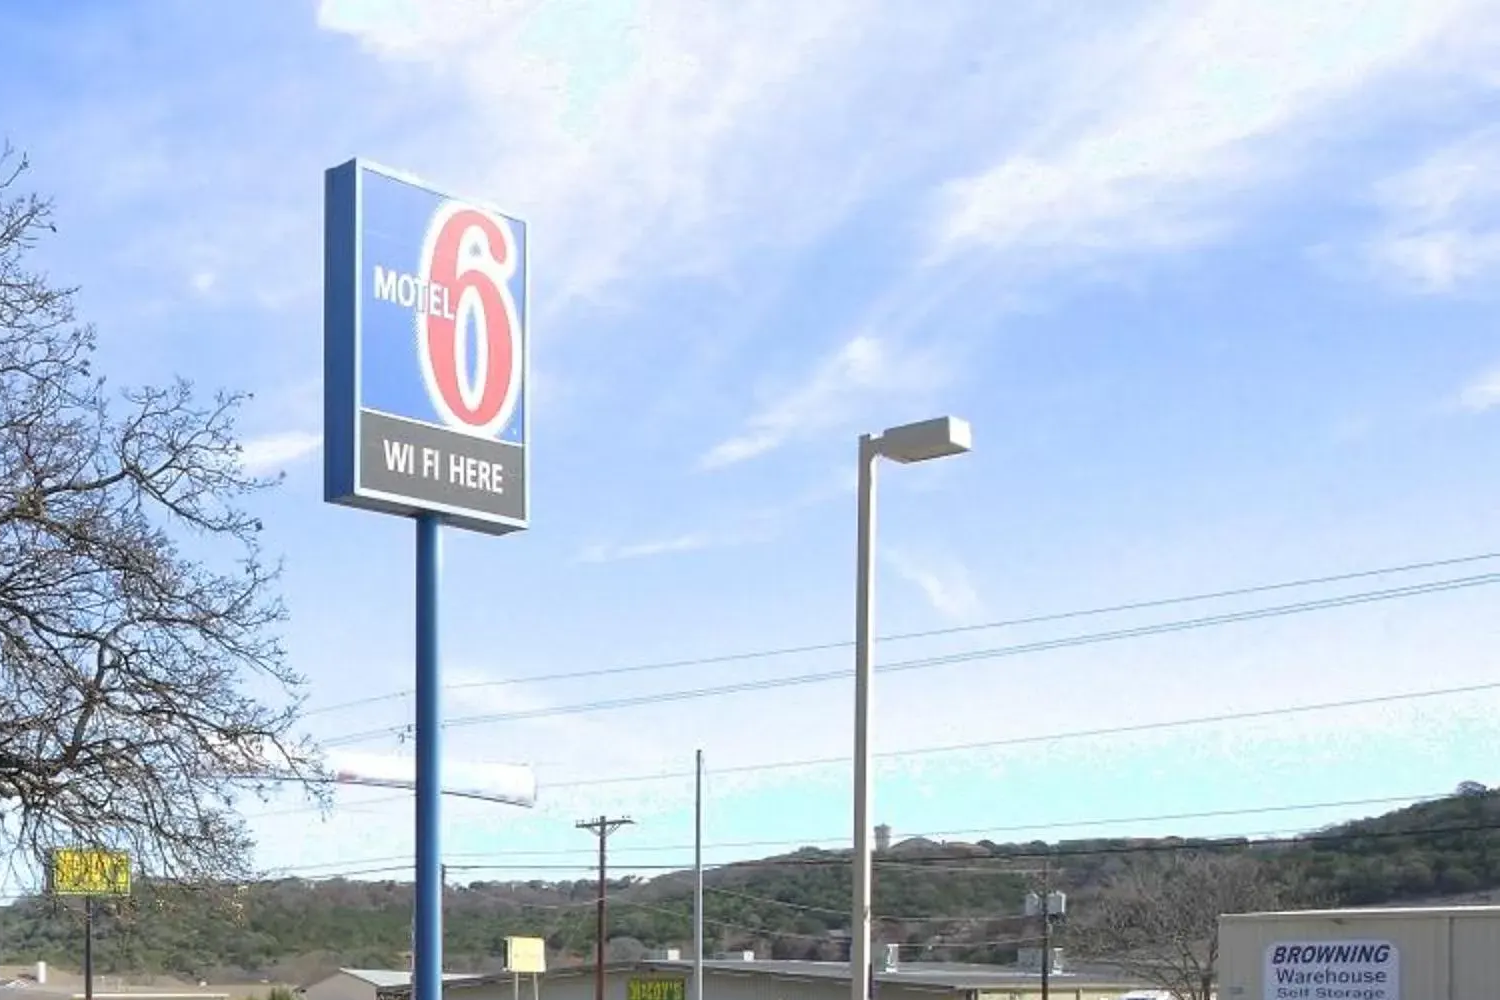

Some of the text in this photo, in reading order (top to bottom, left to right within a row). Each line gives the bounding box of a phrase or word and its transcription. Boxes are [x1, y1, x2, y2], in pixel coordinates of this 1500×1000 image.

[373, 206, 514, 429] MOTEL 6
[383, 439, 504, 494] WI FI HERE
[1272, 944, 1390, 964] BROWNING
[1276, 967, 1387, 984] Warehouse
[1277, 987, 1385, 1000] Self Storage
